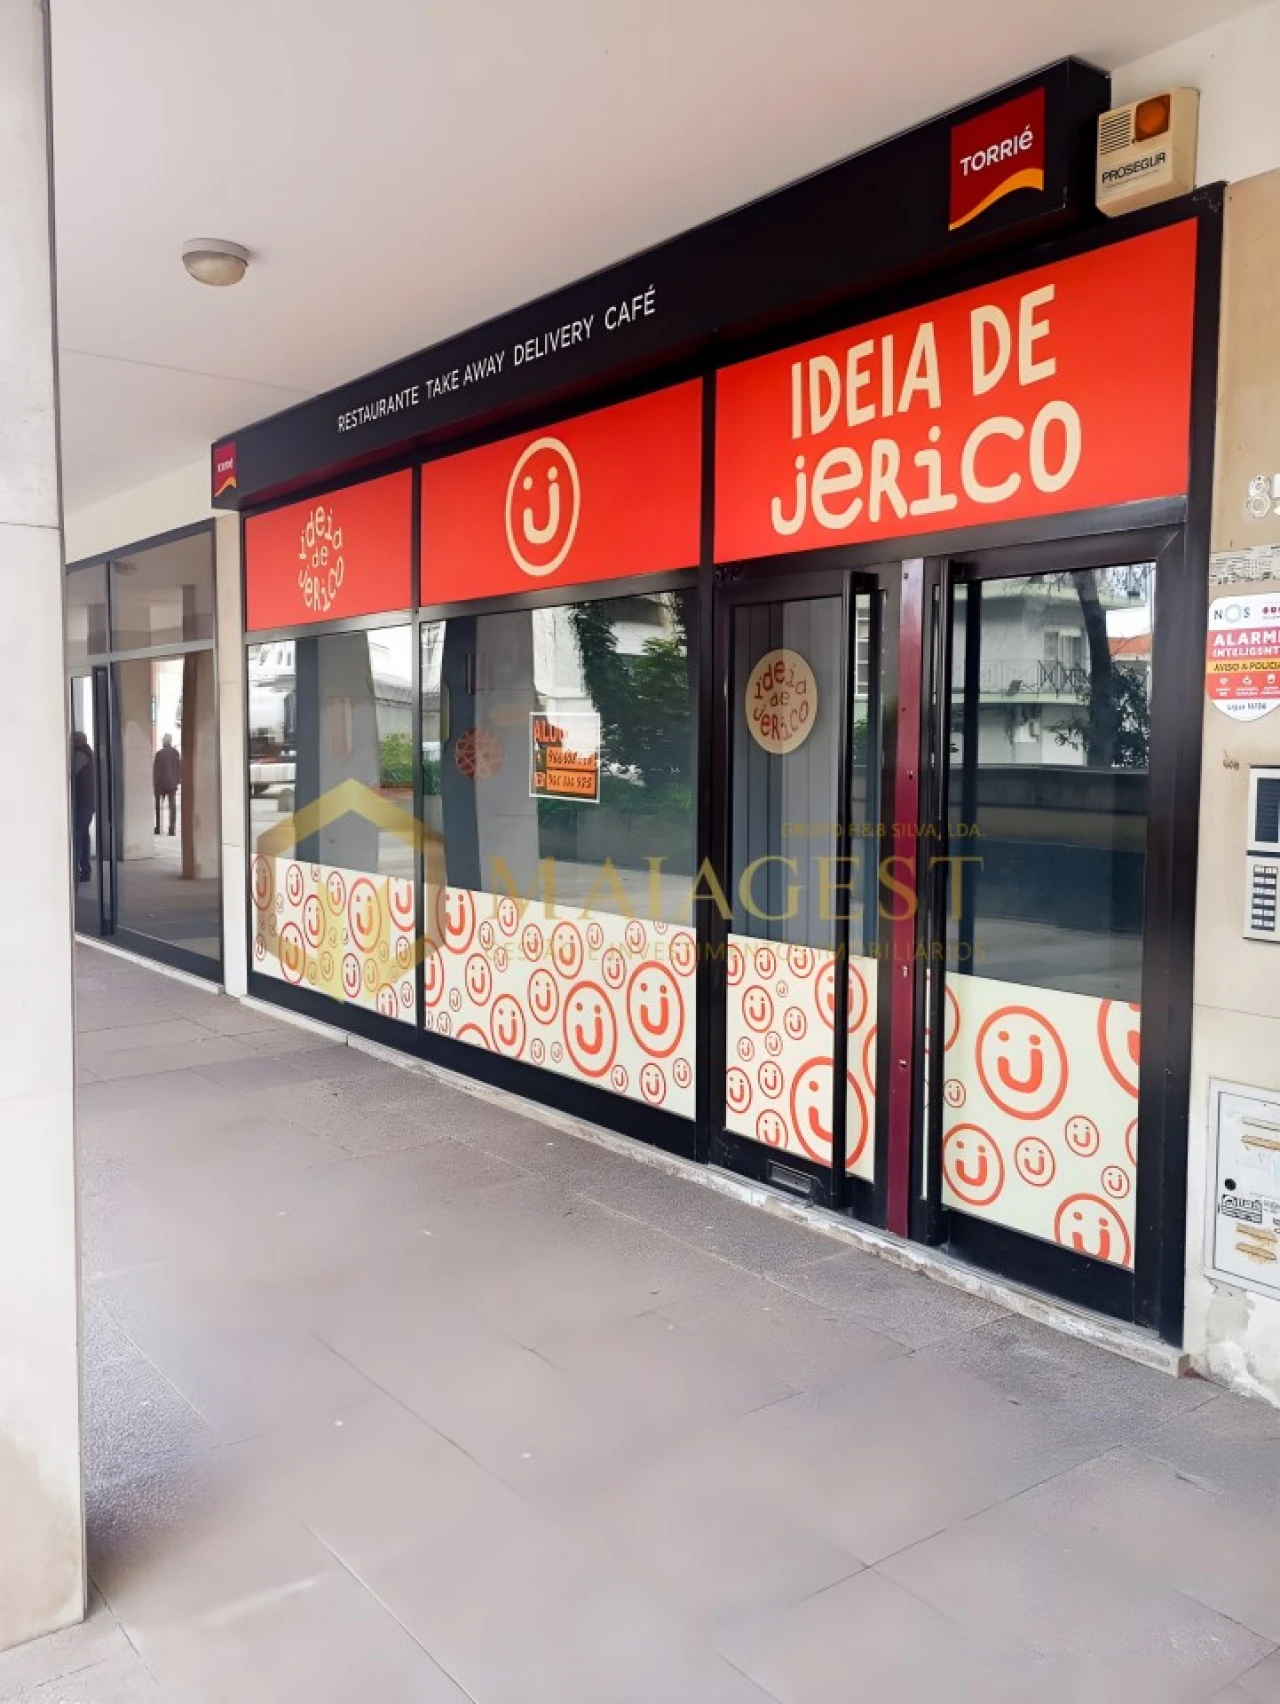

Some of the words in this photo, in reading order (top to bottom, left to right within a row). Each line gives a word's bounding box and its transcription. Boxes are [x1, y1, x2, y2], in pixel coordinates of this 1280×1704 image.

[1102, 152, 1166, 183] PROSEGUR
[337, 384, 419, 433] RESTAURANTE
[426, 369, 460, 400] TAKE
[463, 350, 505, 386] AWAY
[514, 314, 594, 367] DELIVERY
[604, 283, 656, 331] CAFÉ
[791, 321, 942, 440] IDEIA
[971, 283, 1057, 397] DE
[312, 546, 329, 568] de
